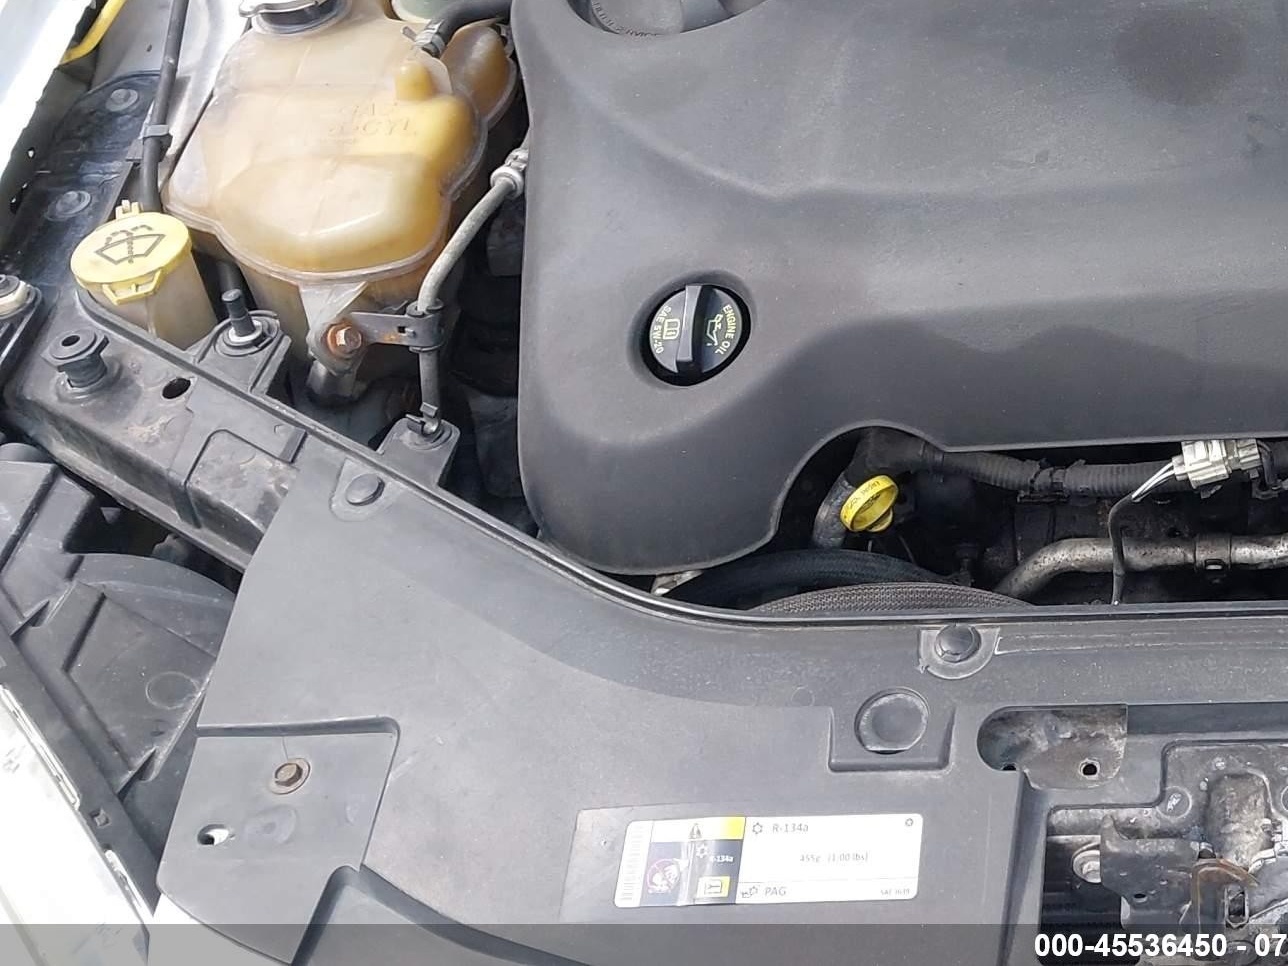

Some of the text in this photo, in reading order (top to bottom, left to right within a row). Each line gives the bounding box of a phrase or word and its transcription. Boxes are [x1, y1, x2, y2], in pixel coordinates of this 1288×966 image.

[655, 305, 672, 323] SAE
[714, 304, 736, 355] ENGINE OIL
[772, 822, 810, 833] R-134a
[765, 886, 788, 897] PAG
